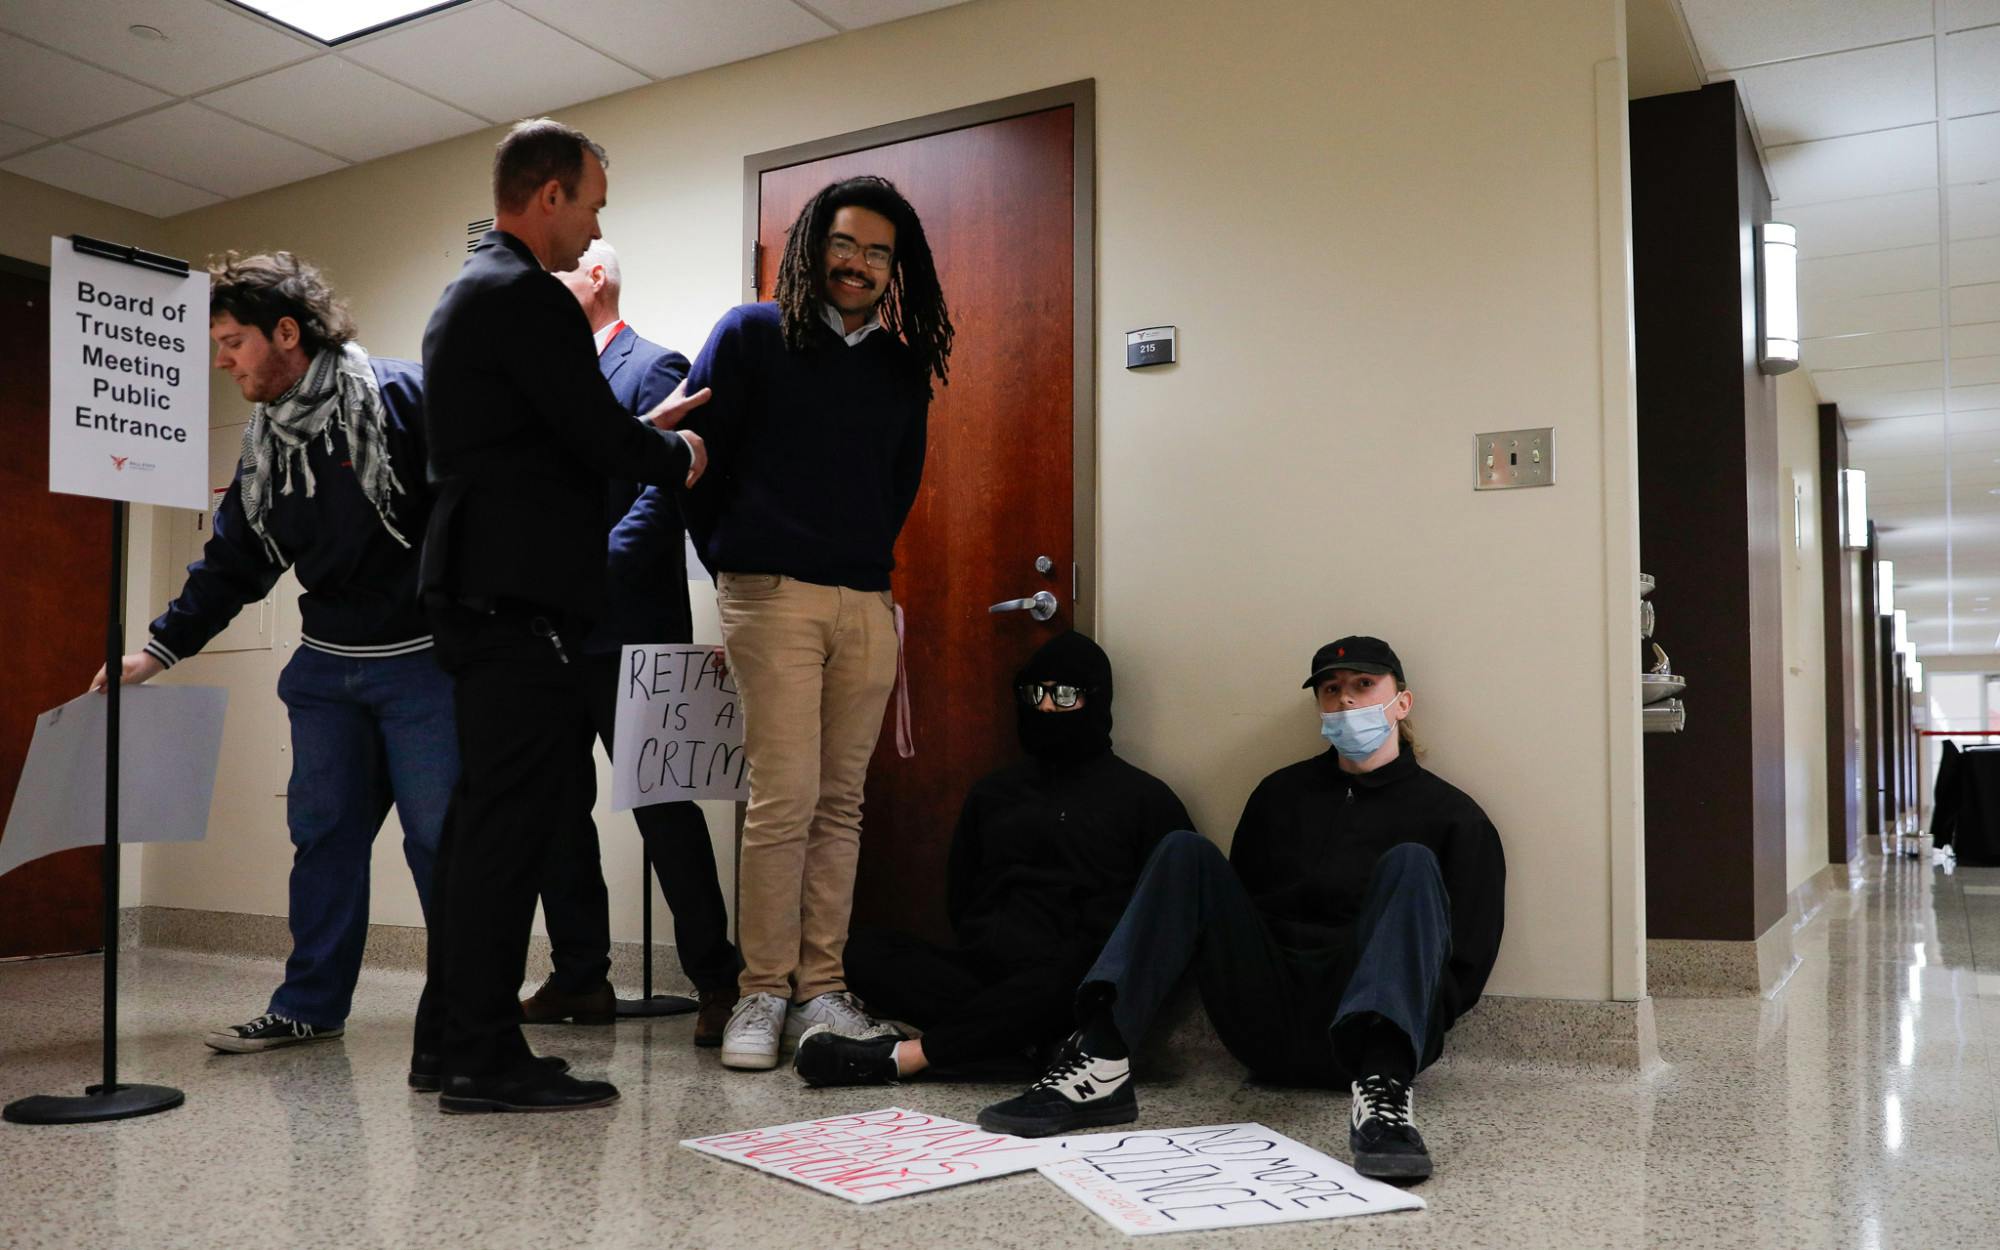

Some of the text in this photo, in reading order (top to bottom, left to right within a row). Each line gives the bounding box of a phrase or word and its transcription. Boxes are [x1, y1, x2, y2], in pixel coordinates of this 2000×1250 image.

[77, 281, 187, 323] Board of
[75, 312, 186, 353] Trustees
[1139, 343, 1156, 354] 215
[82, 344, 181, 387] Meeting
[93, 377, 171, 411] Public
[75, 406, 187, 443] Entrance
[629, 649, 738, 701] RETAL
[662, 702, 735, 731] IS A
[637, 737, 746, 794] CRIM
[1073, 1080, 1097, 1100] N
[778, 1127, 980, 1177] BETRAYS
[812, 1110, 1041, 1157] BRIAN
[696, 1131, 931, 1196] BENEFICENCE
[1062, 1135, 1283, 1221] SILENCE
[1166, 1127, 1369, 1209] NO MORE
